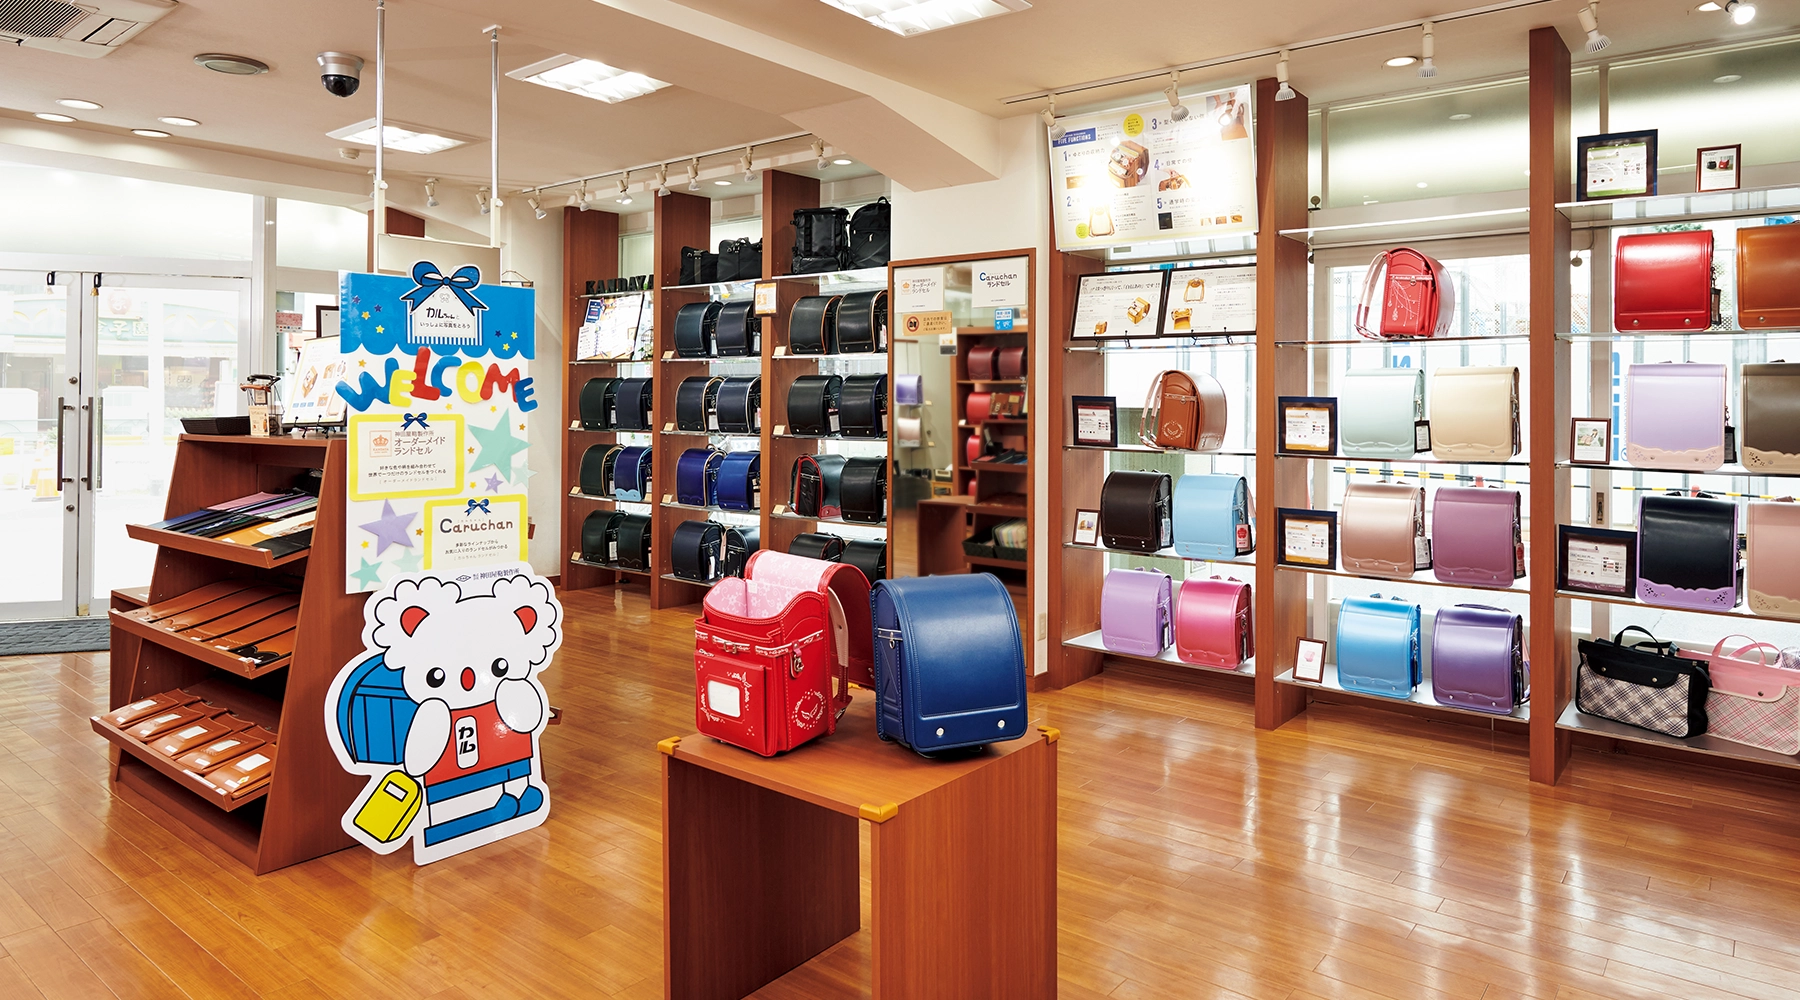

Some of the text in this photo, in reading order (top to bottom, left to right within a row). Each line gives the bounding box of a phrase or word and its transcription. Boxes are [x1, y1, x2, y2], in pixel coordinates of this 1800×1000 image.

[1152, 118, 1157, 130] 3
[1156, 198, 1163, 209] 5
[979, 271, 1017, 281] Caruchan
[987, 280, 1011, 288] ランドセル
[419, 321, 471, 329] いっしょに写真をとろう
[335, 346, 538, 412] WELCOME
[394, 436, 446, 447] オーダーメイド
[394, 446, 433, 456] ランドセル
[368, 469, 447, 478] 世界で一つだけのランドセルをつくれる
[440, 518, 513, 533] Caruchan
[455, 539, 499, 548] 多彩なラインナップから
[444, 544, 508, 555] お気に入りのランドセルがみつかる
[458, 724, 476, 755] カル
